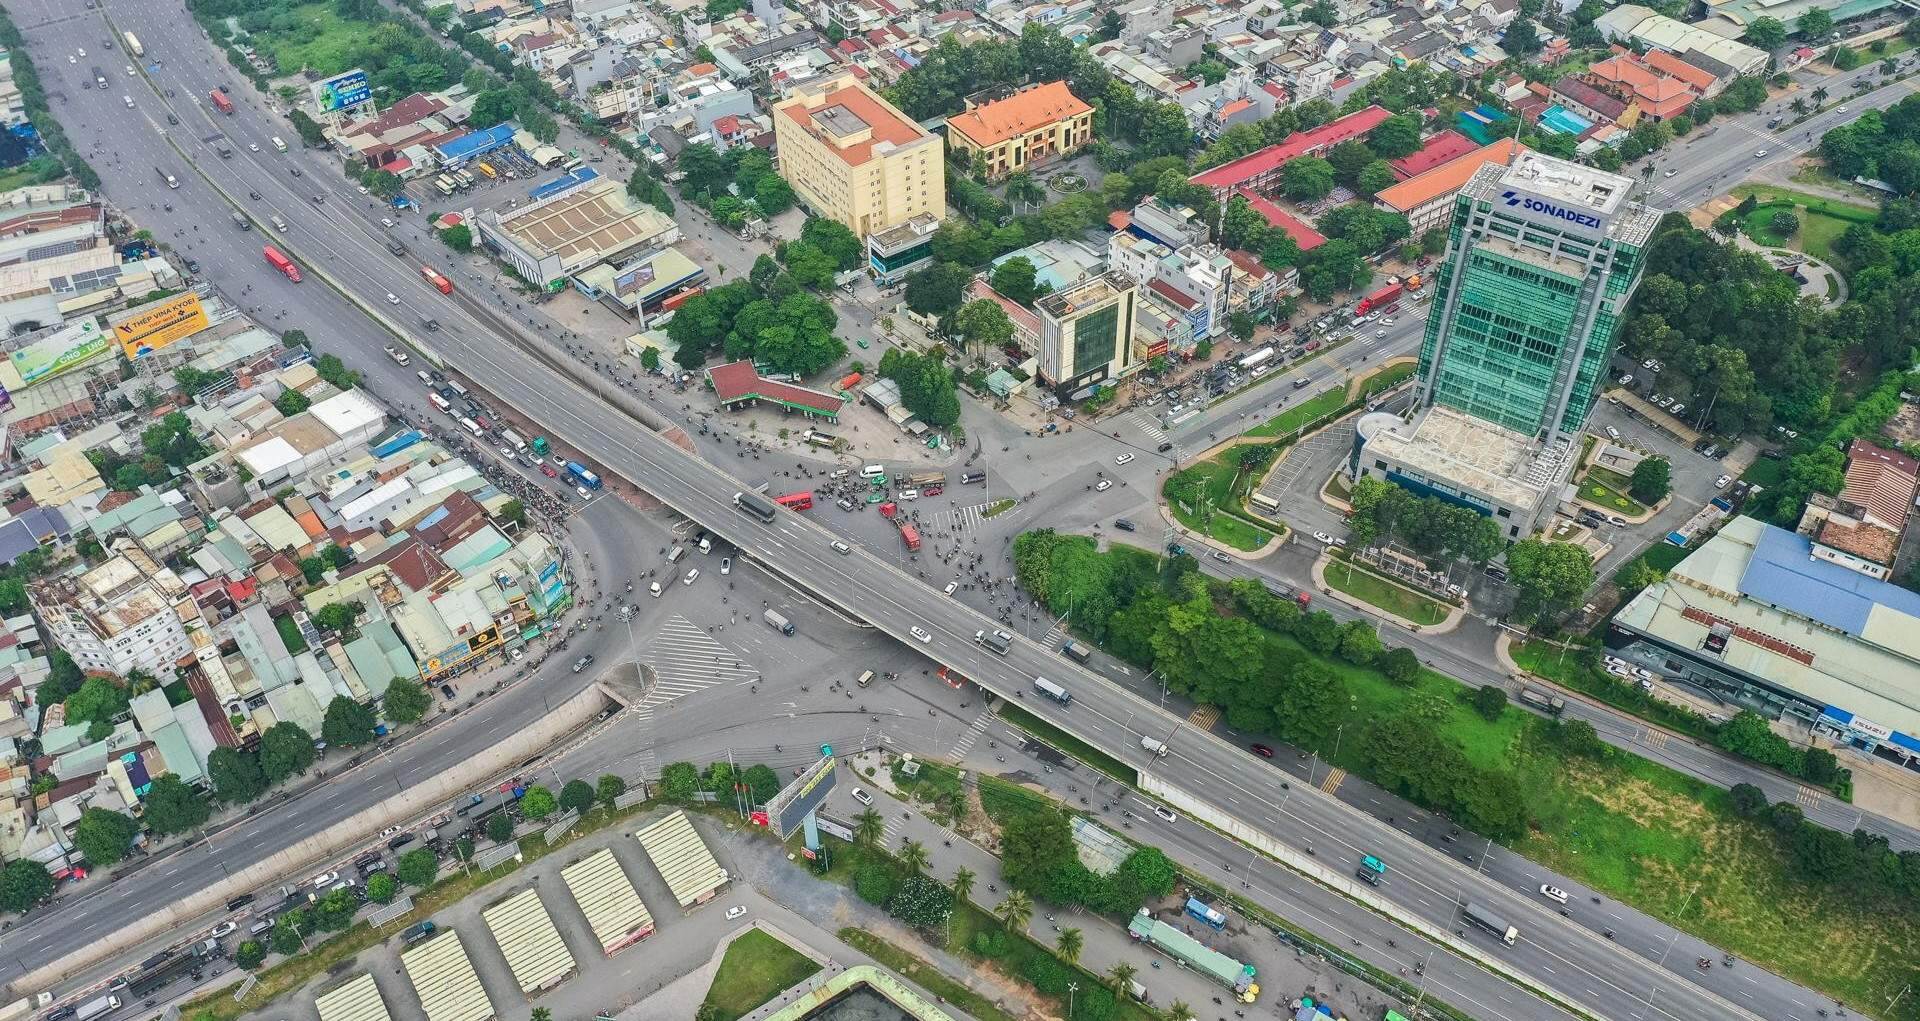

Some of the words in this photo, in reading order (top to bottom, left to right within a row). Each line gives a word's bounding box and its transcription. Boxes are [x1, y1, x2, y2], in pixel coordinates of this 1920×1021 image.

[1523, 198, 1600, 229] SONADEZI
[153, 308, 172, 319] VINA
[172, 298, 195, 311] KYOEI
